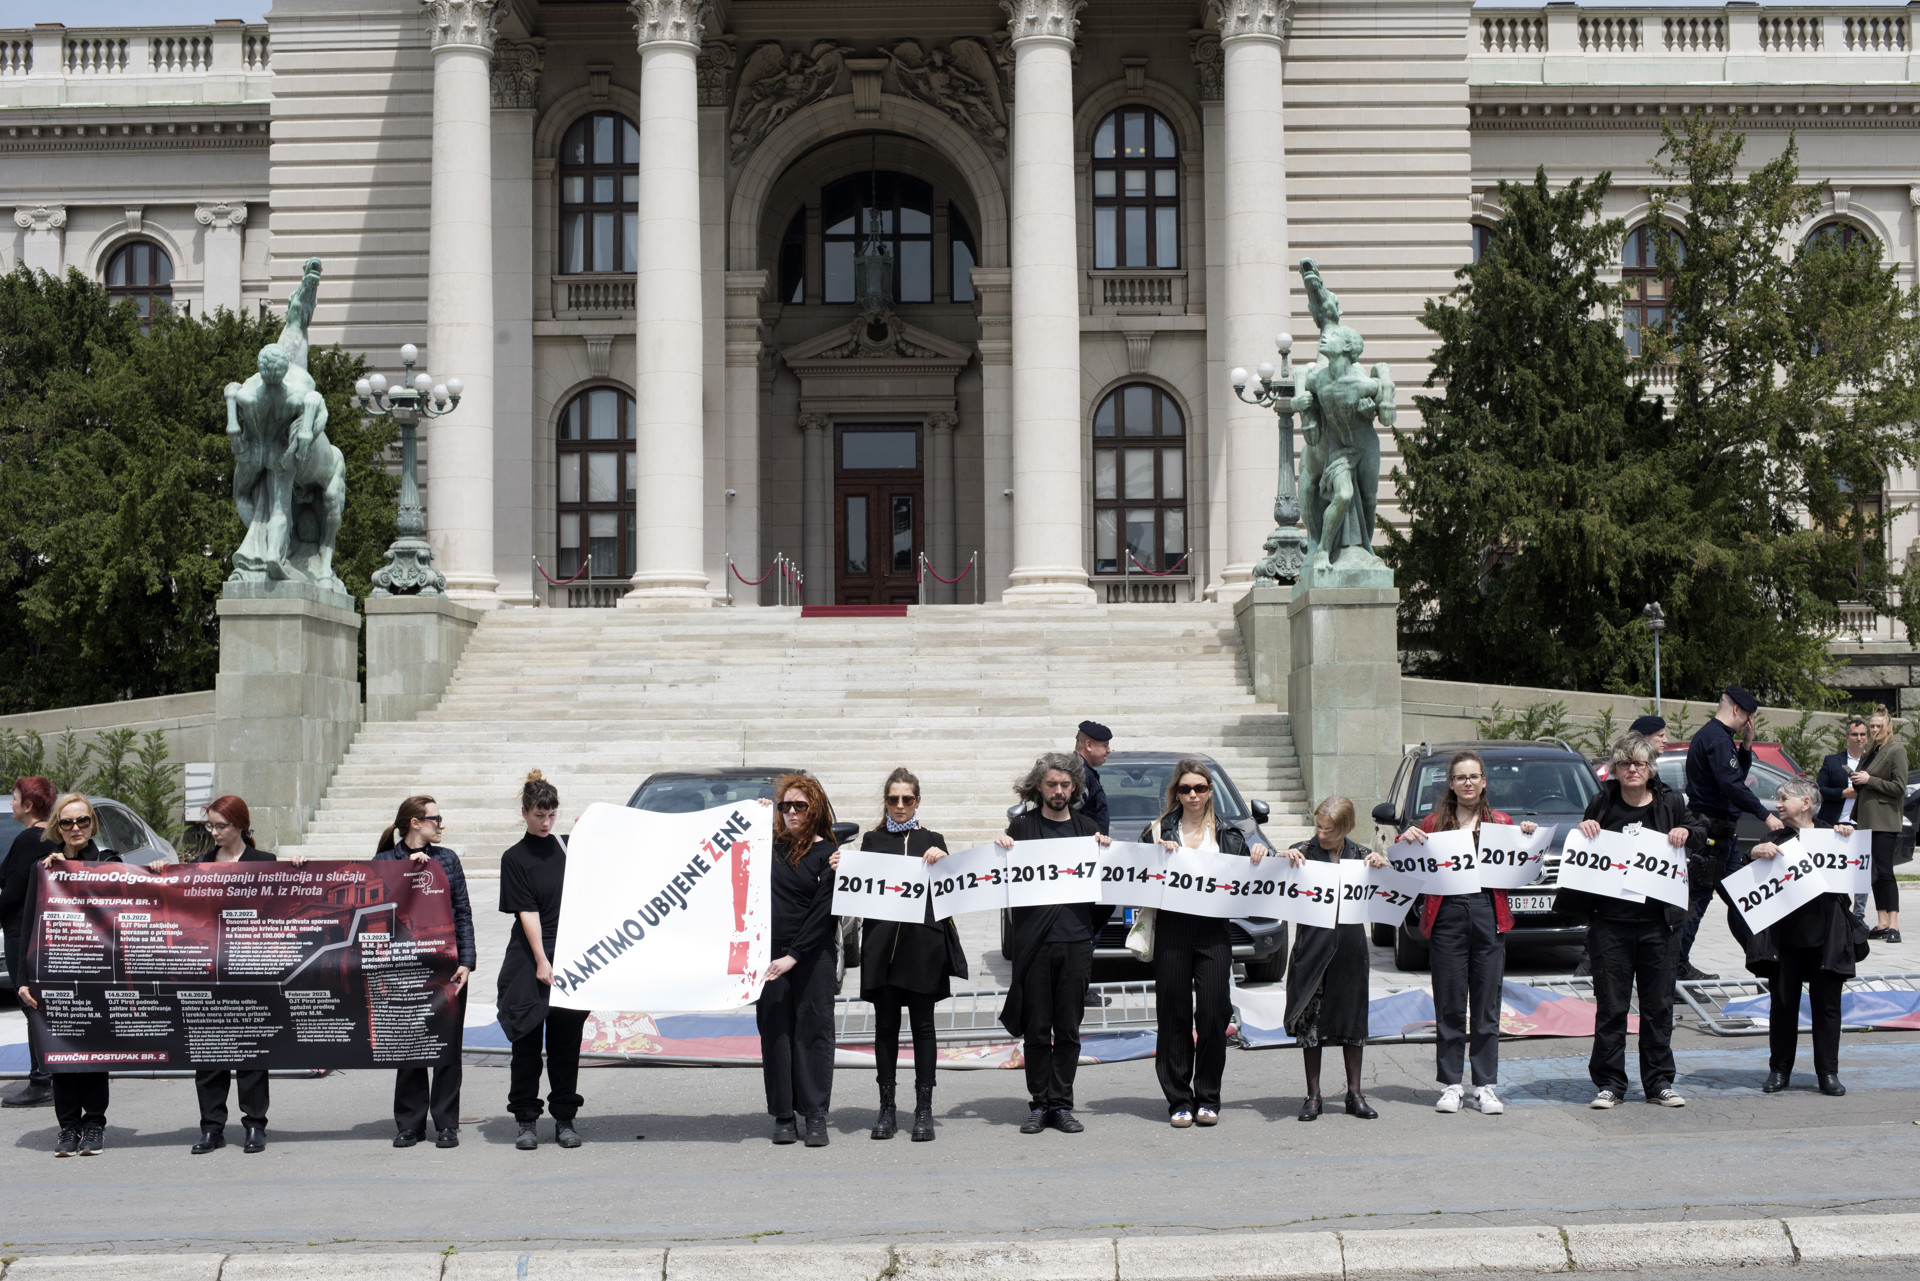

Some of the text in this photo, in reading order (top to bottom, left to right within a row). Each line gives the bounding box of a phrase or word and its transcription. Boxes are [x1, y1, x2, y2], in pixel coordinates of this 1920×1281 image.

[1396, 854, 1475, 873] 2018 32
[1481, 848, 1528, 866] 2019
[1565, 849, 1611, 871] 2020
[1633, 853, 1678, 879] 2021
[1807, 853, 1870, 870] 023 27
[48, 871, 179, 884] #TražimoOdgovore
[183, 874, 191, 882] o
[193, 872, 255, 884] postupanju
[258, 871, 312, 884] institucija
[326, 870, 366, 883] slučaju
[1012, 862, 1096, 883] 2013 47
[1102, 866, 1149, 883] 2014
[183, 886, 322, 898] ubistva Sanje M. iz Pirota
[838, 876, 925, 898] 2011 29
[934, 873, 978, 897] 2012
[1168, 872, 1216, 893] 2015
[1230, 880, 1250, 896] 36
[1252, 880, 1334, 904] 2016 35
[1738, 859, 1812, 912] 2022 28
[48, 897, 85, 905] KRIVIČNI
[553, 810, 752, 996] PAMTIMO UBIJENE ŽENE
[1344, 884, 1413, 906] 2017 27
[1509, 898, 1521, 908] BG
[48, 1053, 88, 1061] KRIVIČNI
[91, 1053, 138, 1061] POSTUPAK
